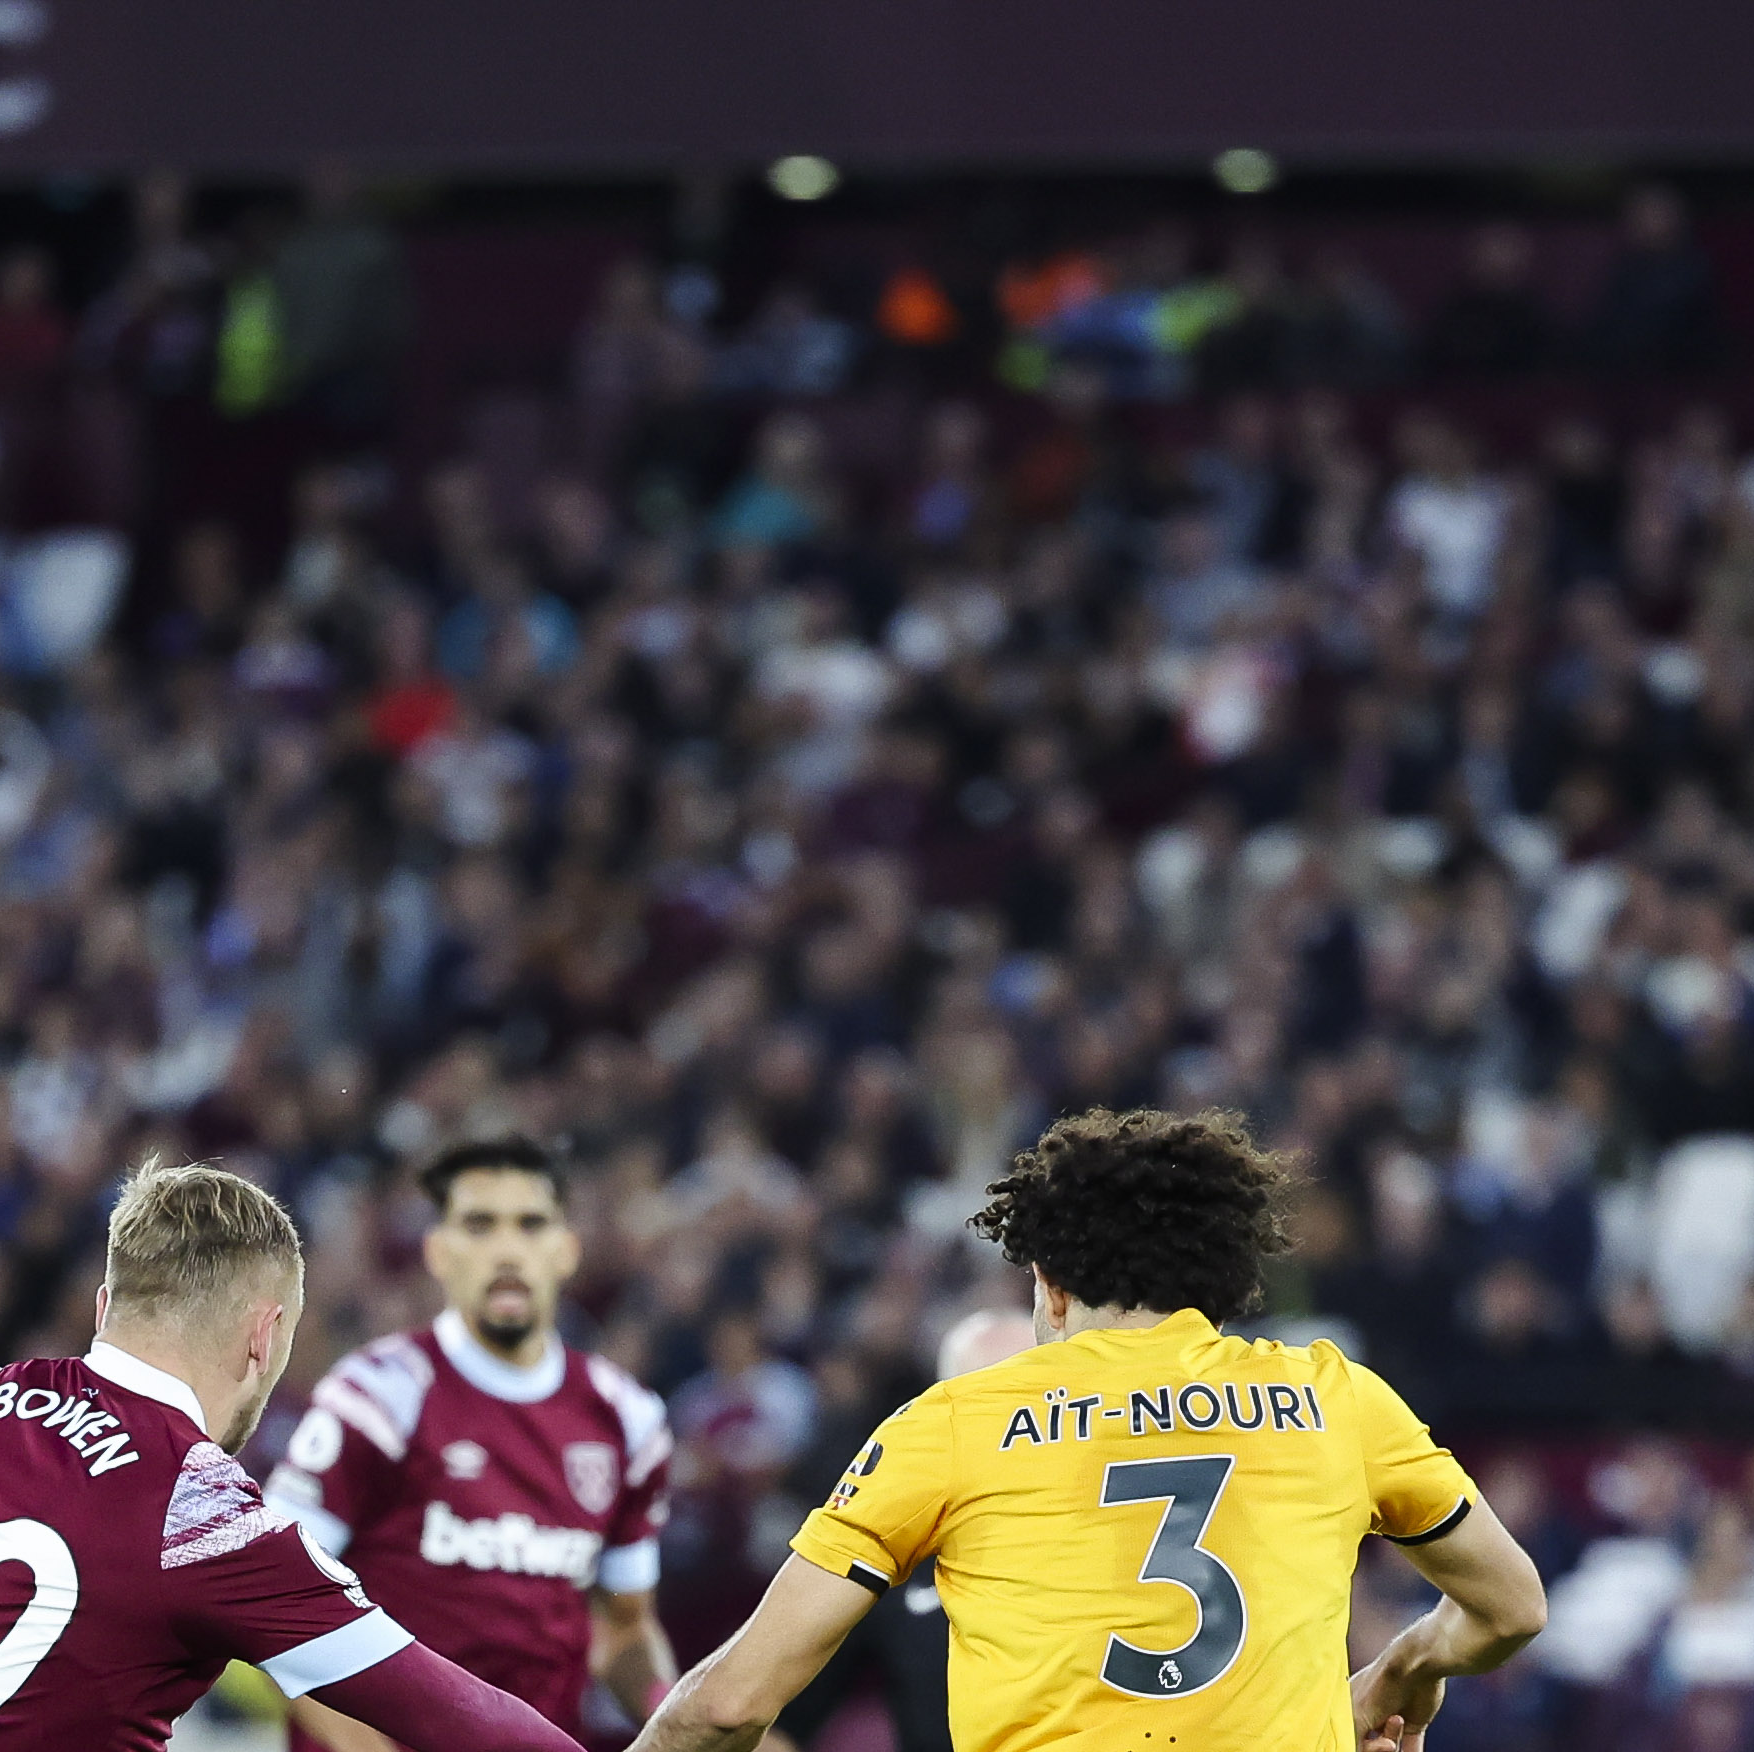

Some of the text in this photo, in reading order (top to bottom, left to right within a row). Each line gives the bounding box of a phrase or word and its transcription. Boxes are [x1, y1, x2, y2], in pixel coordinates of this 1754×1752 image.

[998, 1382, 1326, 1451] AÏT-NOURI
[419, 1499, 604, 1590] betway
[1098, 1453, 1248, 1699] 3
